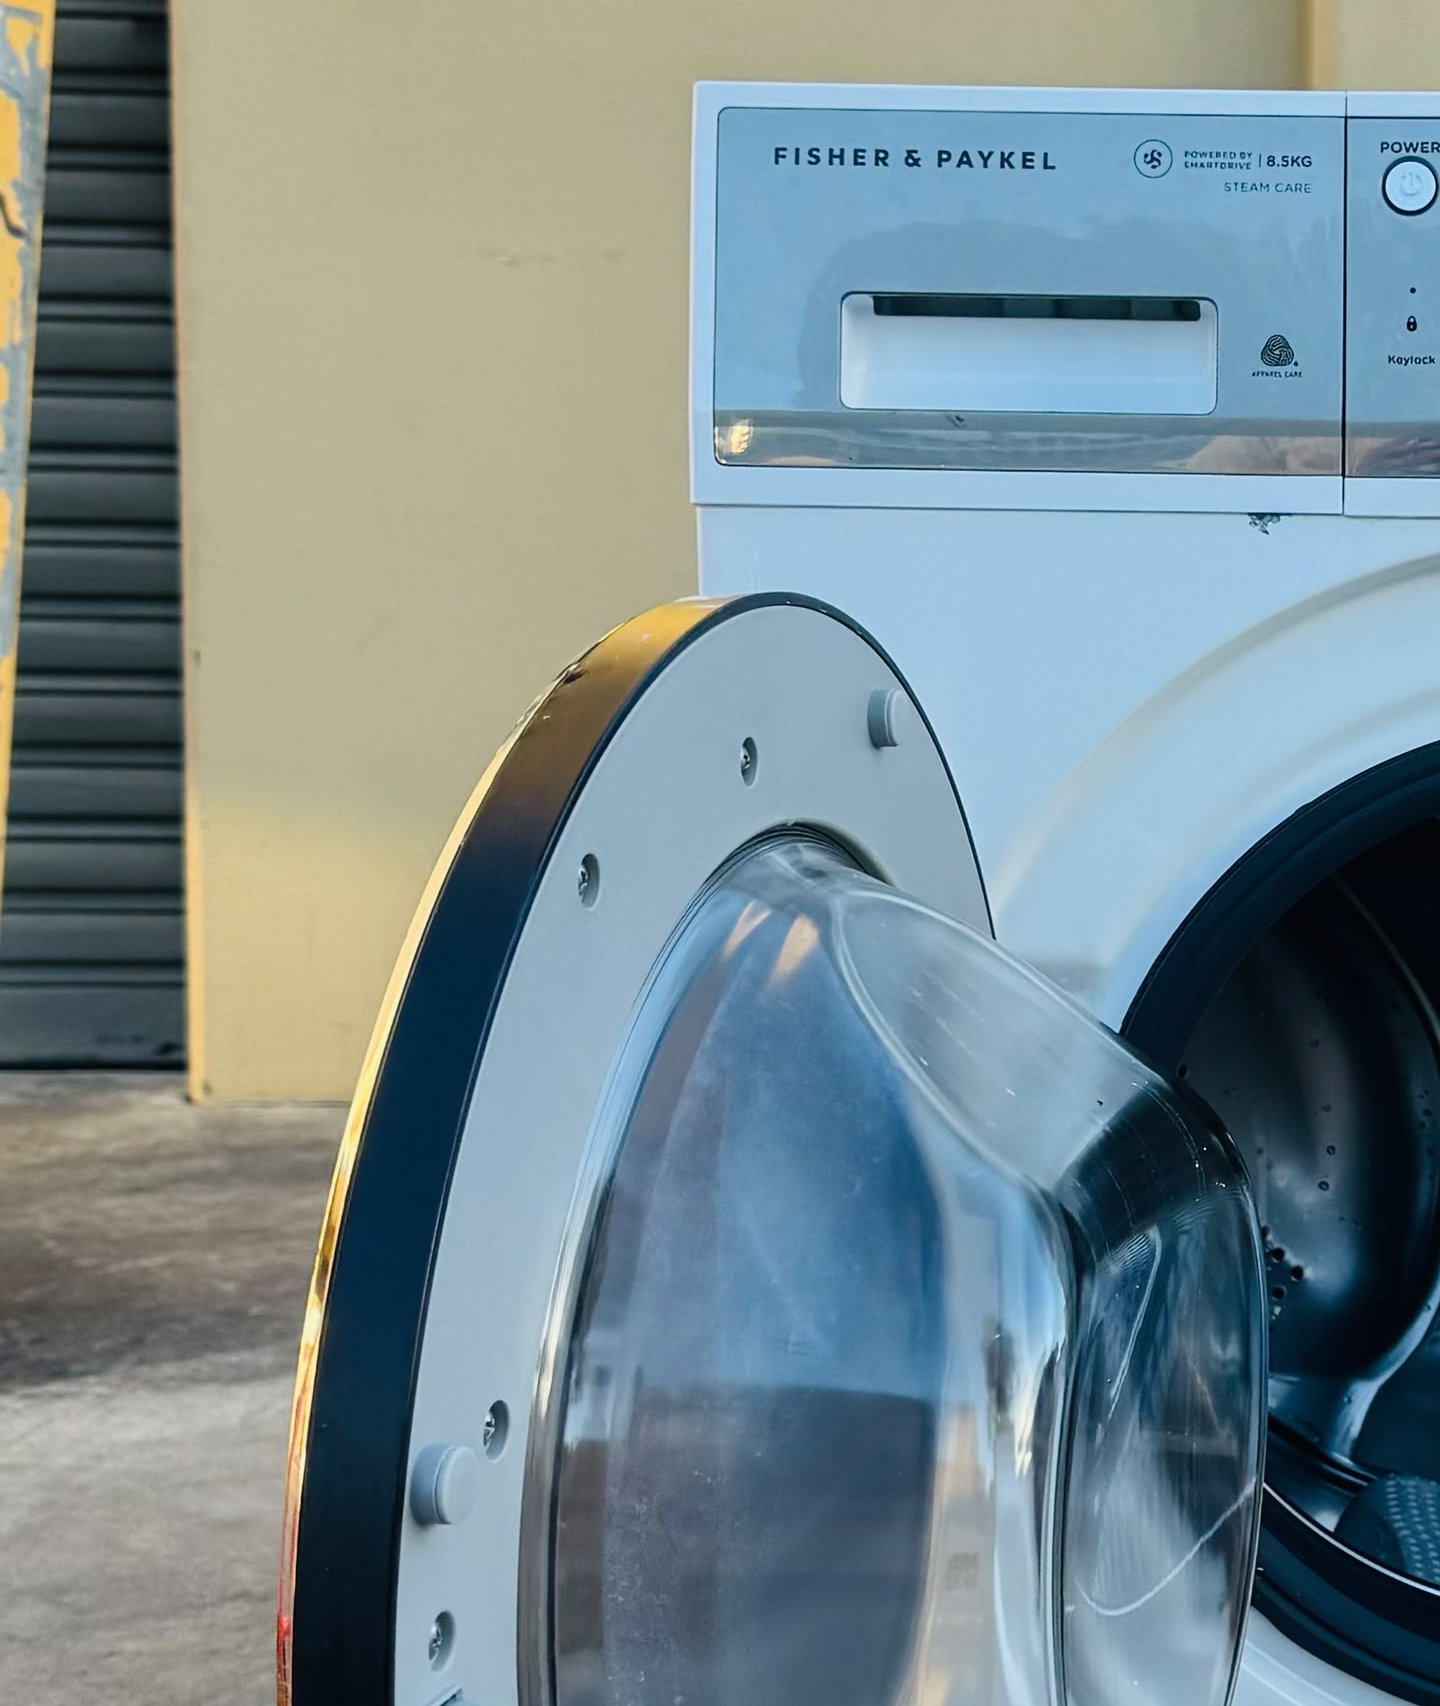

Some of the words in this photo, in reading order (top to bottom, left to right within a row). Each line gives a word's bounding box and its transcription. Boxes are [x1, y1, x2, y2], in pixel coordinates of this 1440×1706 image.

[1380, 141, 1440, 154] POWER
[774, 147, 889, 168] FISHER
[904, 149, 922, 168] &
[937, 150, 1057, 171] PAYKEL
[1266, 155, 1312, 167] 8.5KG
[1224, 182, 1270, 192] STEAM
[1275, 183, 1311, 193] CARE
[1387, 354, 1436, 367] Keylock
